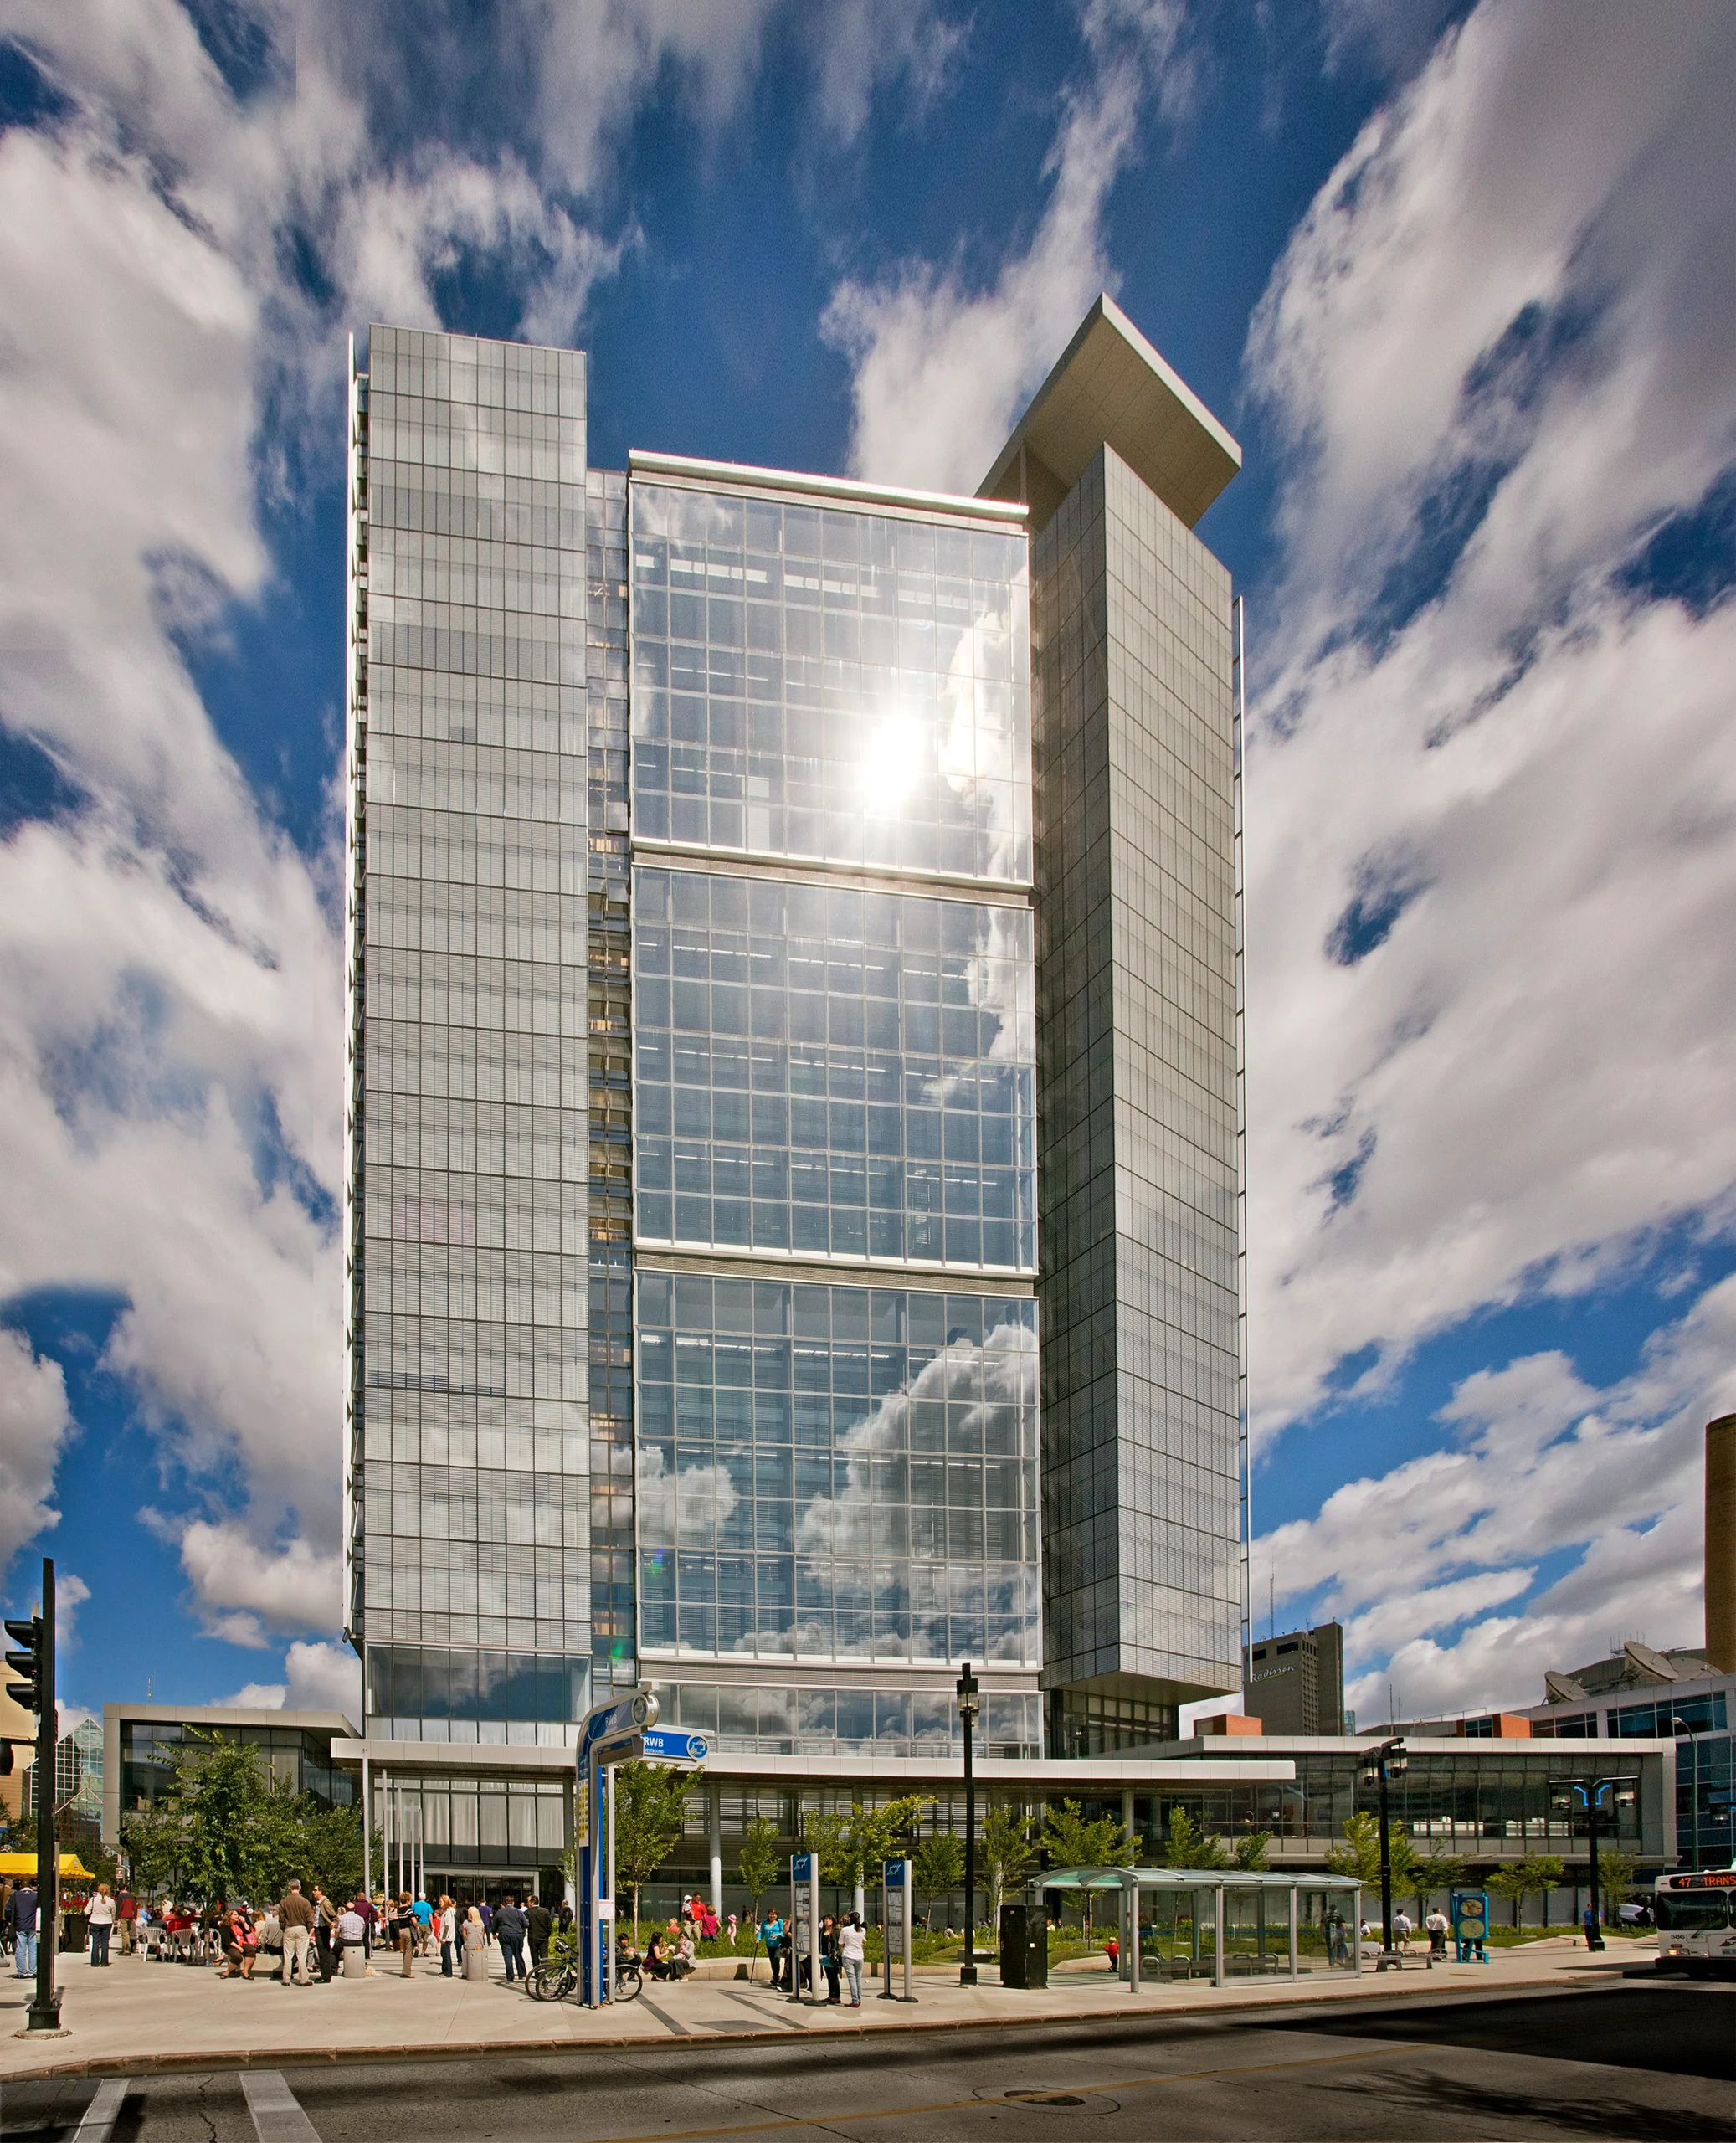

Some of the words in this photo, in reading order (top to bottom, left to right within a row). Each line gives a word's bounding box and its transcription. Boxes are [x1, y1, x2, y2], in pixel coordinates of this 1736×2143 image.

[1252, 1666, 1294, 1682] Radisson
[644, 1736, 664, 1747] RWB
[1679, 1878, 1691, 1887] 47
